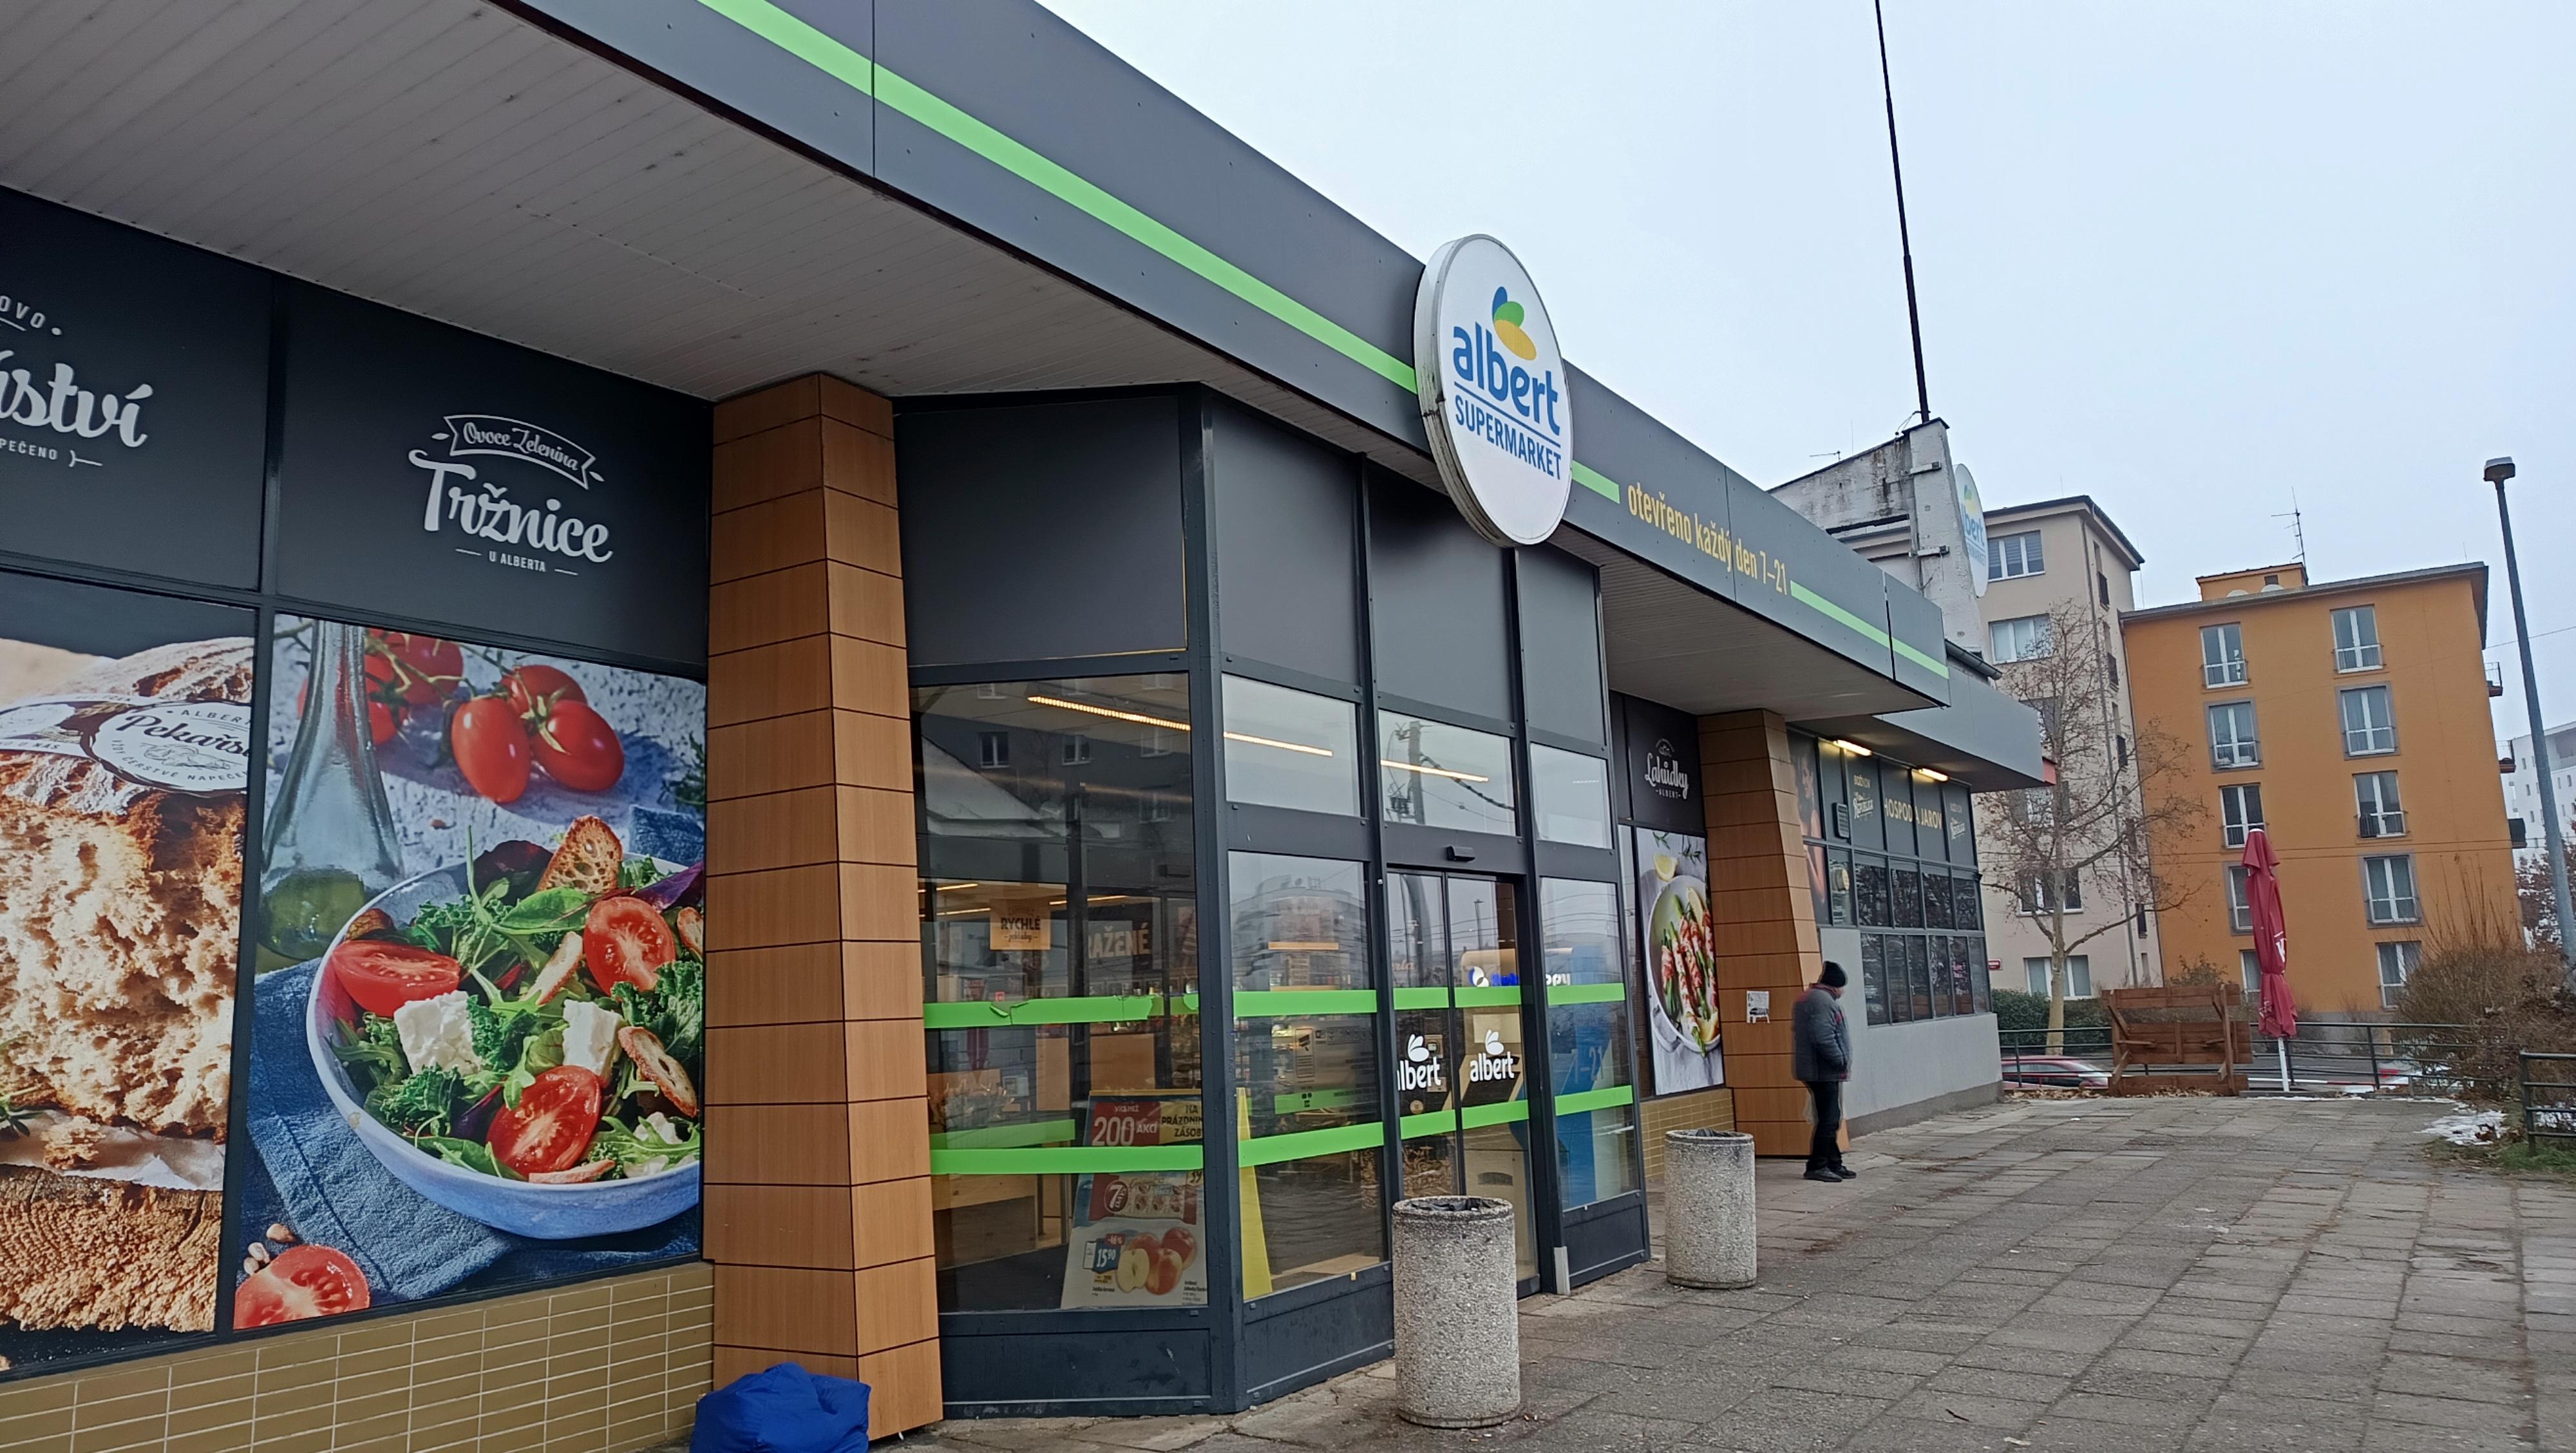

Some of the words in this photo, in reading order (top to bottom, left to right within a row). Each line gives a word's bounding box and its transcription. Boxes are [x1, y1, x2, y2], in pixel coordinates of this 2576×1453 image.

[1453, 321, 1560, 435] albert
[462, 422, 511, 446] Ovoce
[511, 426, 578, 471] Zelenina
[1455, 394, 1561, 480] SUPERMARKET
[408, 449, 613, 562] Tržnice
[1627, 482, 1692, 544] otevřeno
[1694, 513, 1733, 573] každý
[1736, 538, 1757, 580] den
[489, 551, 497, 562] U
[500, 553, 546, 573] ALBERTA
[116, 714, 249, 757] Pekařs
[1920, 808, 1942, 830] JAROV
[1001, 915, 1041, 930] RYCHLÉ
[1470, 1051, 1515, 1083] albert
[1185, 1104, 1198, 1114] NA
[1092, 1117, 1135, 1146] 200
[1136, 1121, 1158, 1134] AKCÍ
